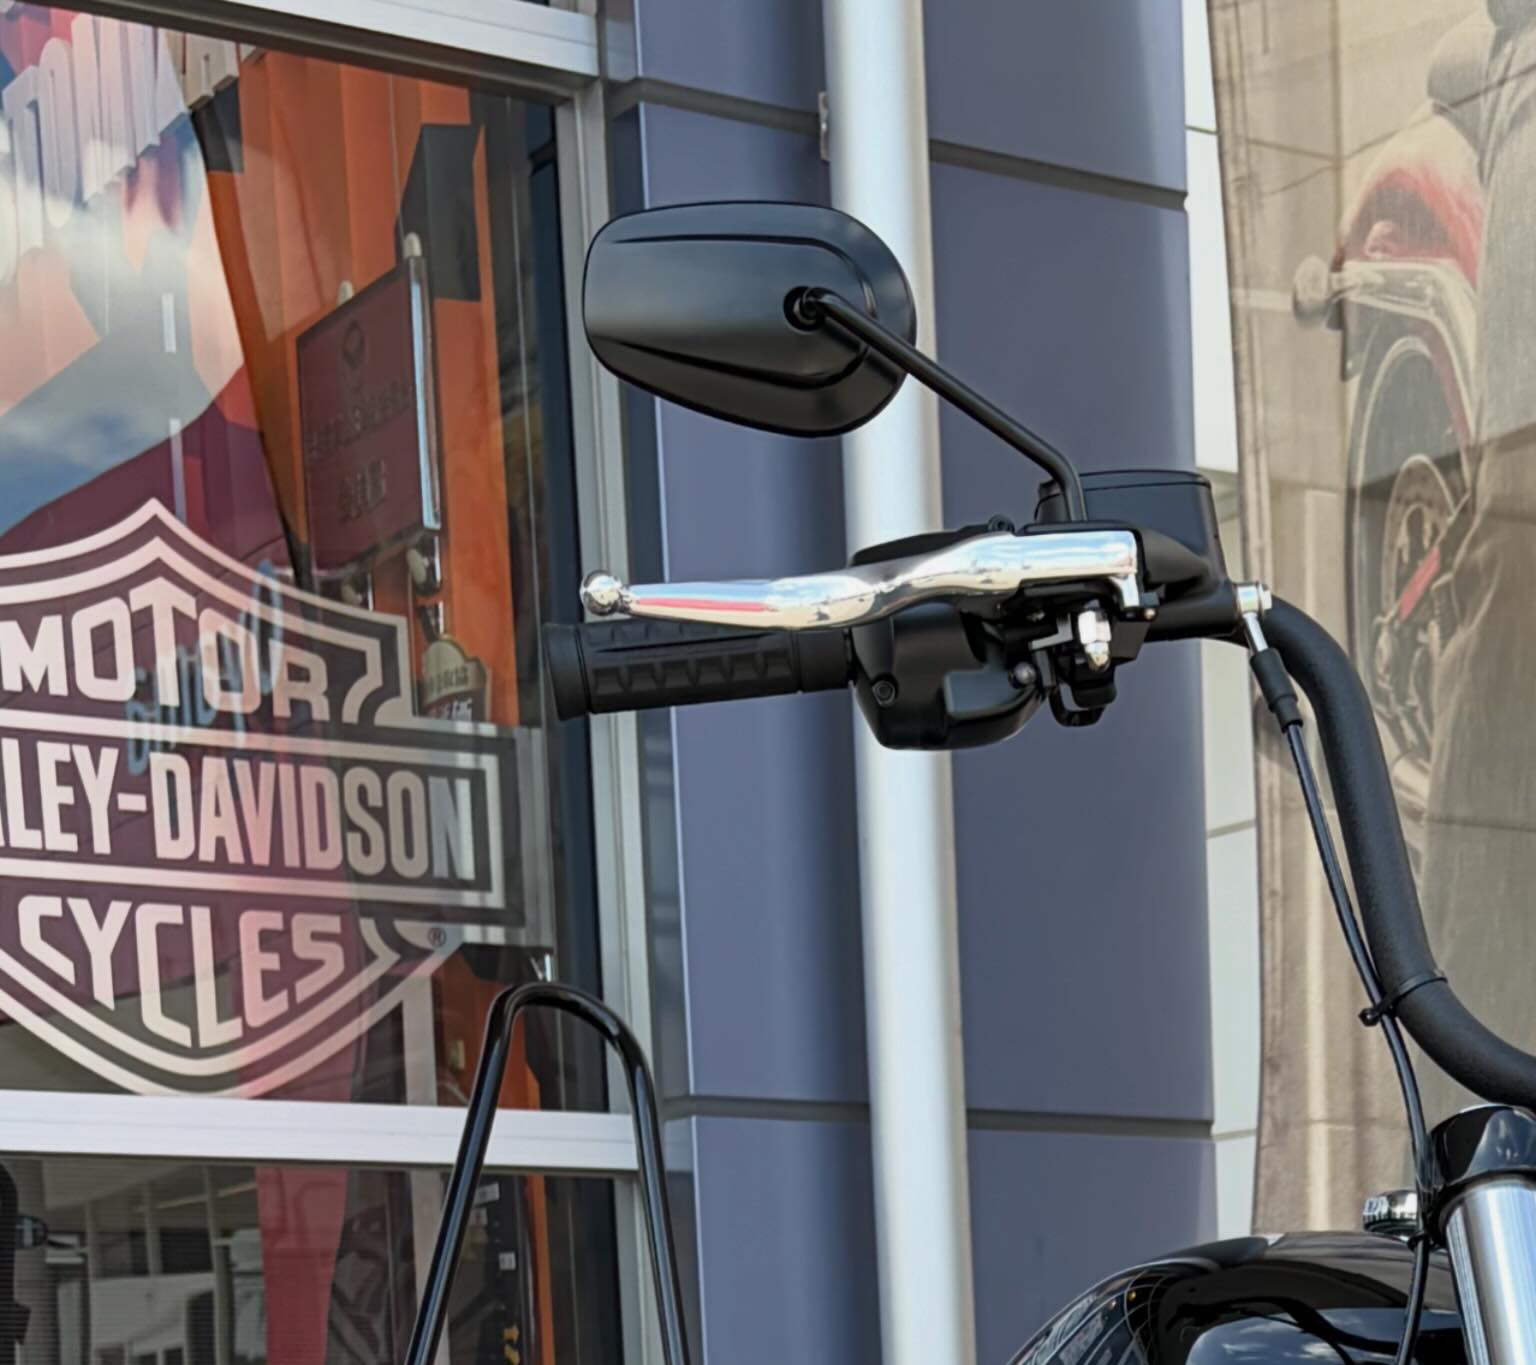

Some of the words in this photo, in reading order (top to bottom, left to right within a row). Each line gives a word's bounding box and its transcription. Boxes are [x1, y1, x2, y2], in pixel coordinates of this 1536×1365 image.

[0, 576, 331, 723] MOTOR
[0, 737, 476, 881] LEY-DAVIDSON
[17, 895, 346, 1049] CYCLES
